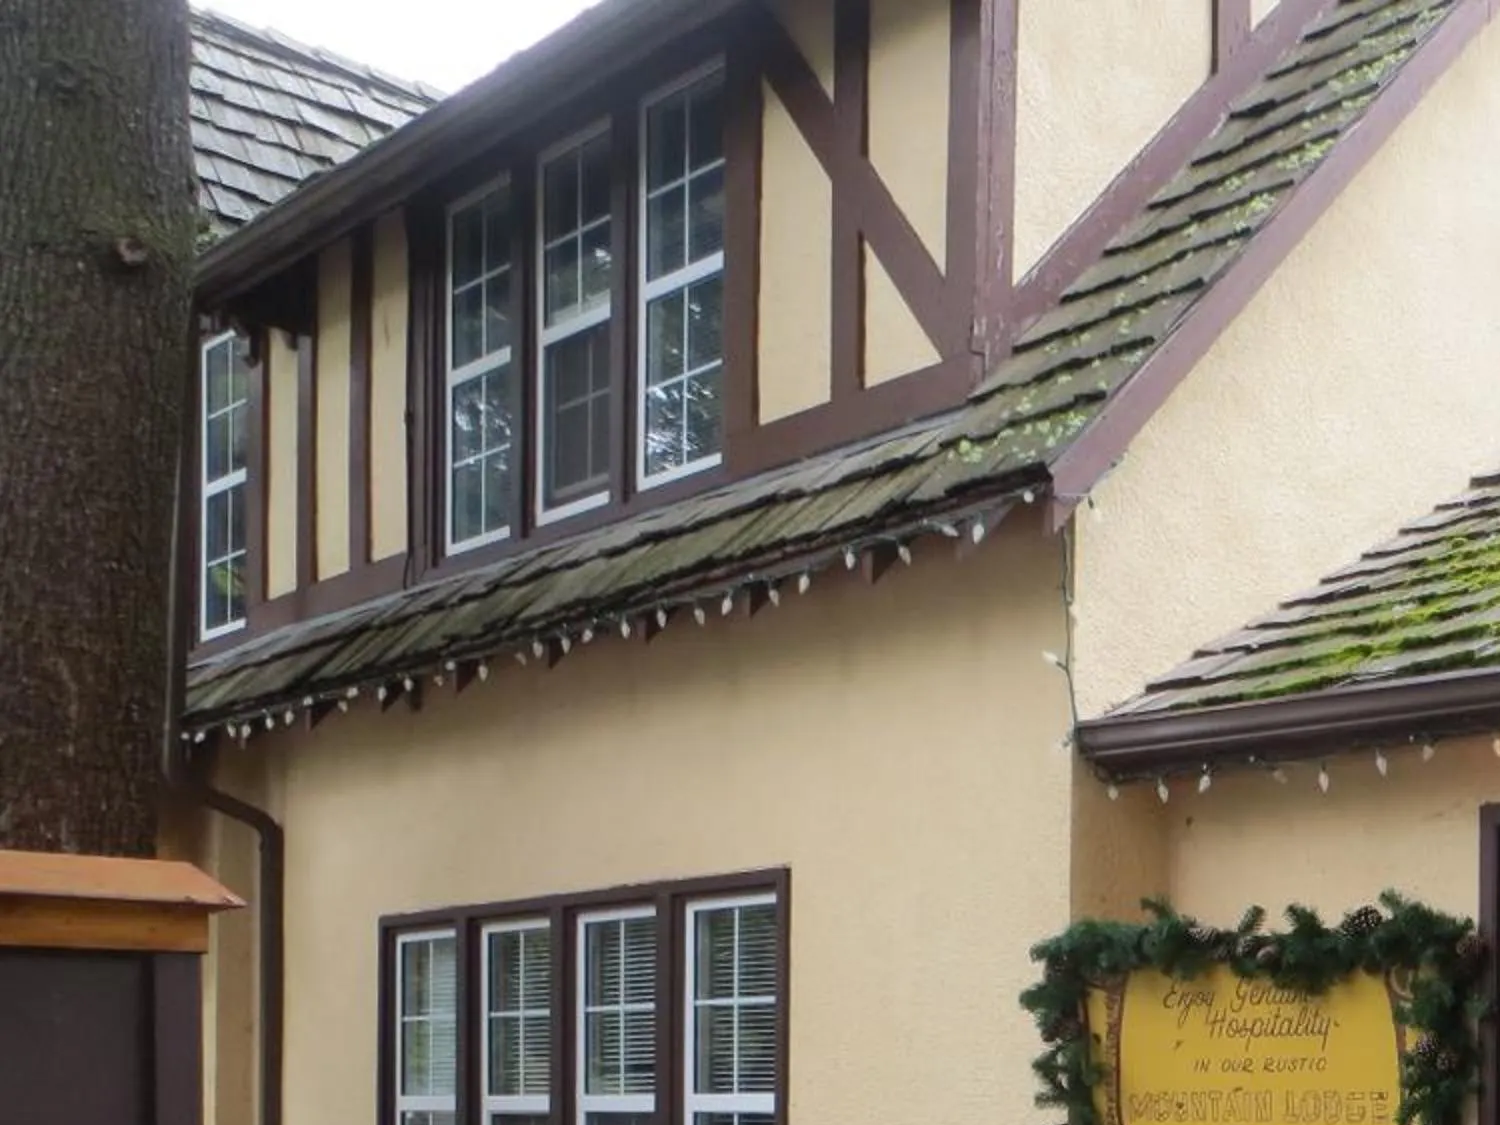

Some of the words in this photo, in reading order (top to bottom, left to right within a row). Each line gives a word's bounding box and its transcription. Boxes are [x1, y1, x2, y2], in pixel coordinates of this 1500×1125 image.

[1163, 979, 1214, 1028] Enjoy
[1205, 1003, 1331, 1051] Hospitality
[1193, 1058, 1210, 1073] IN
[1221, 1057, 1254, 1073] OUR
[1263, 1057, 1328, 1073] RUSTIC
[1128, 1088, 1273, 1123] MOUNTAIN
[1282, 1088, 1390, 1125] LODGE
